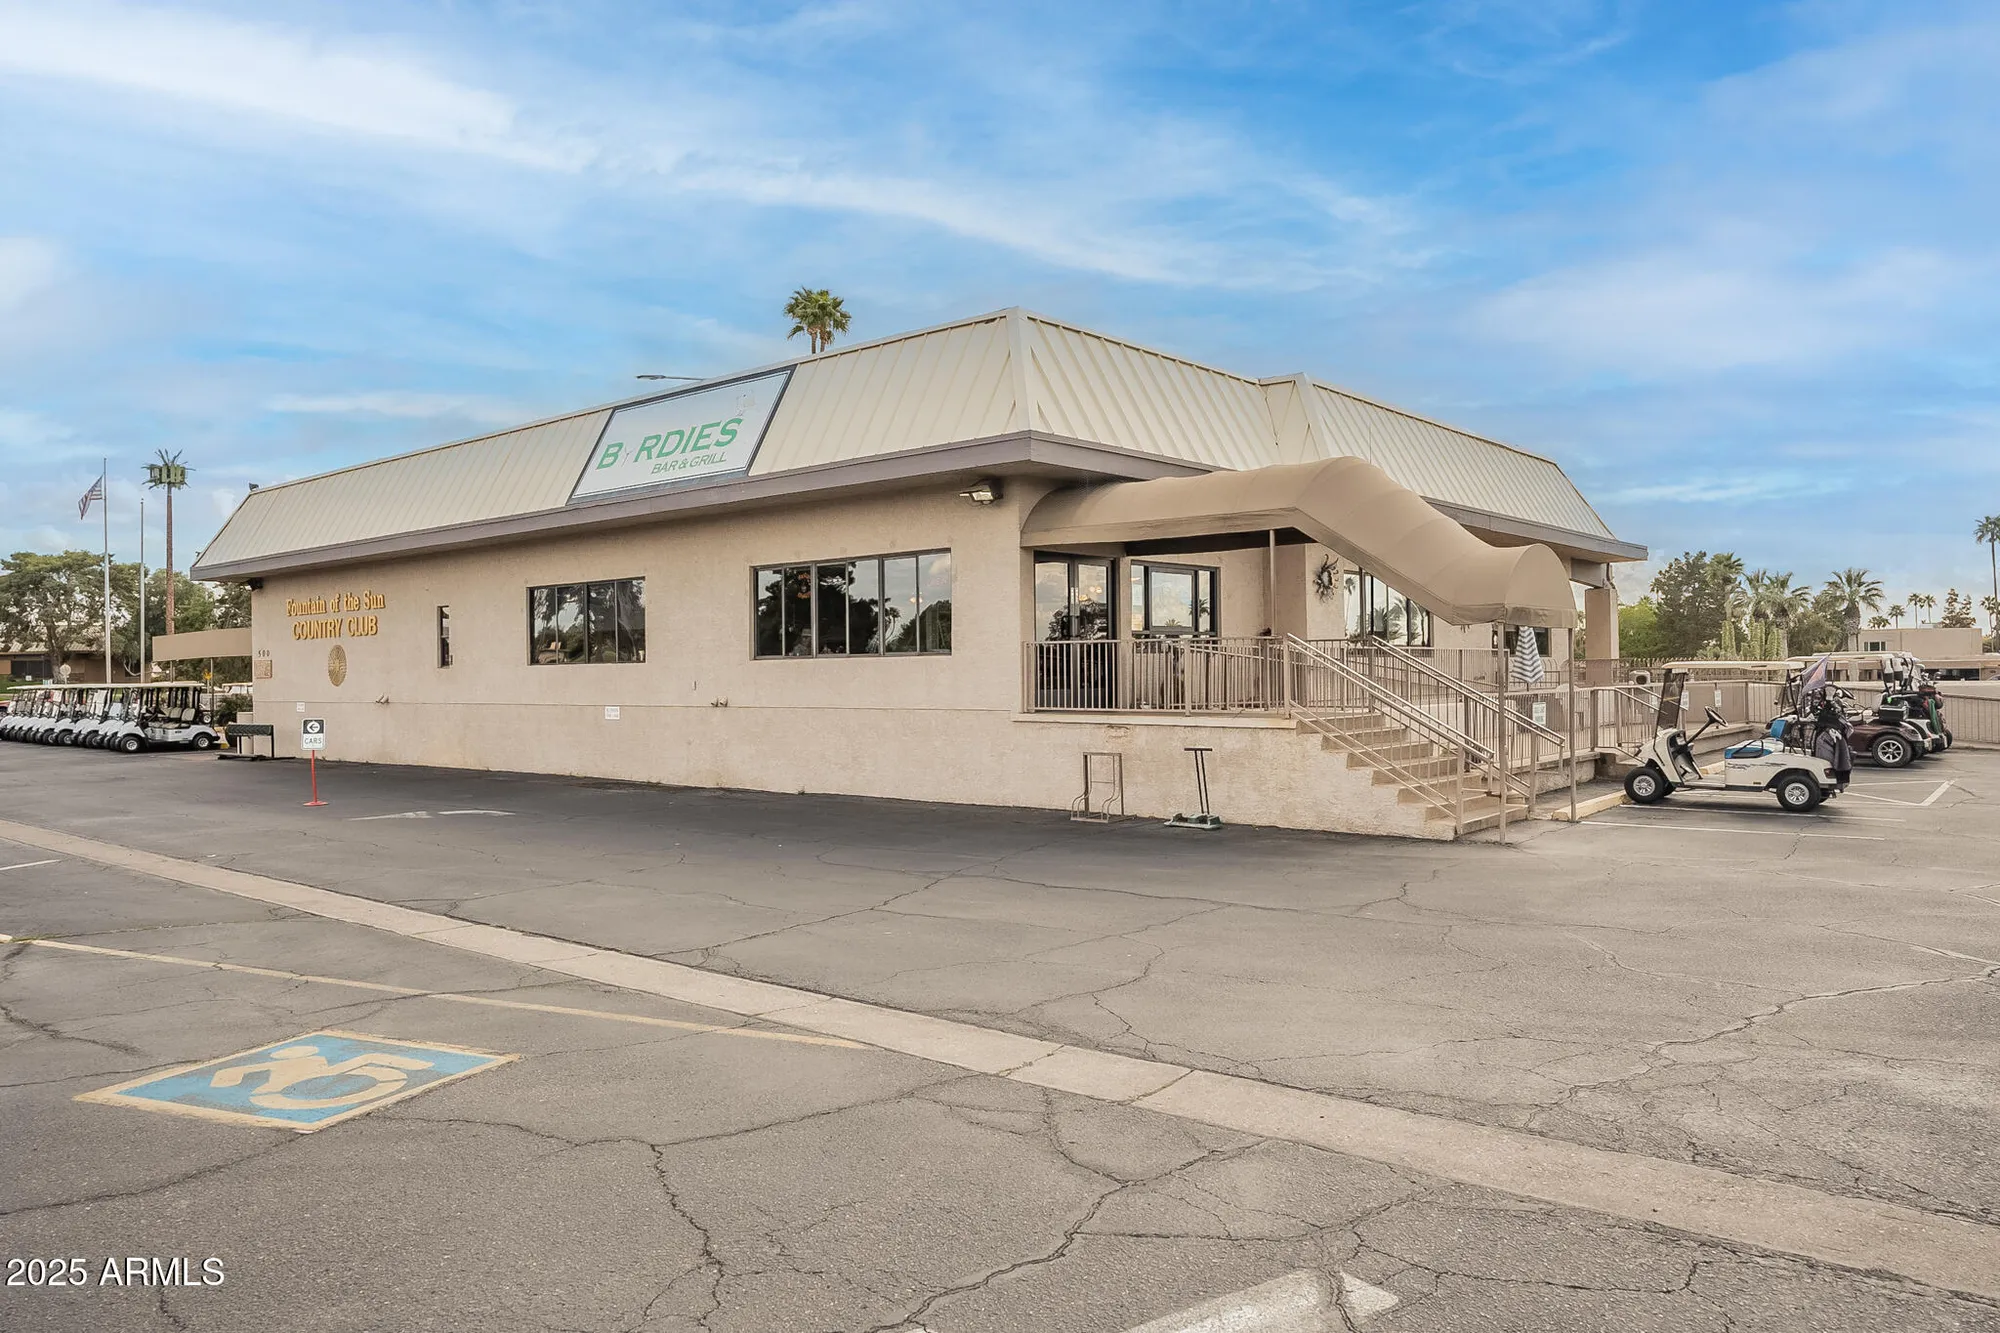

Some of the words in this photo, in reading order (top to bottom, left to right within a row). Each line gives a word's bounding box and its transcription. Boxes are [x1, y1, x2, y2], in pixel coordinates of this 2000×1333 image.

[286, 598, 327, 617] Fountain
[329, 593, 341, 612] of
[343, 592, 360, 612] the
[363, 589, 386, 610] Sun
[293, 618, 344, 641] COUNTRY
[347, 615, 379, 637] CLUB
[304, 737, 322, 745] CARS
